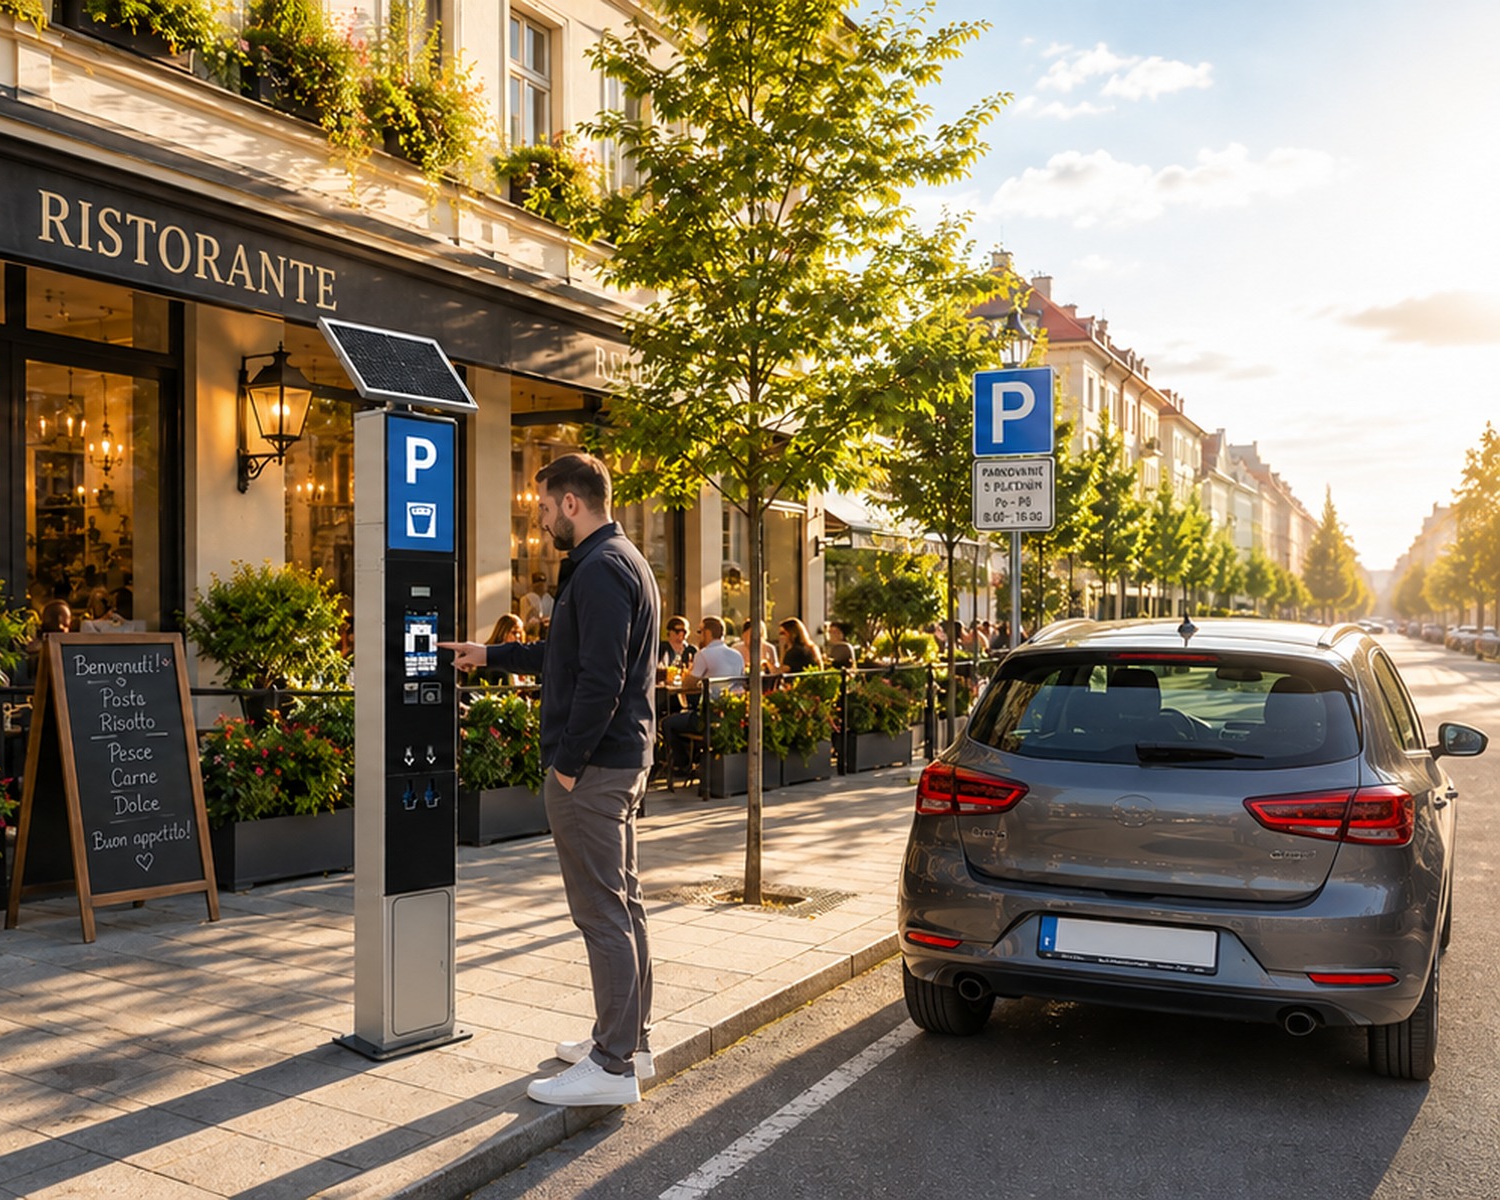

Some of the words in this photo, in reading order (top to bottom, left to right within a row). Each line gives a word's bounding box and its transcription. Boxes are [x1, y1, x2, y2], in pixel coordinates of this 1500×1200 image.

[38, 189, 338, 311] RISTORANTE
[992, 381, 1035, 443] P
[406, 436, 437, 484] P
[99, 711, 155, 732] Risotto
[108, 742, 153, 763] Pesce
[111, 767, 158, 787] Carne
[114, 793, 160, 815] Dolce
[92, 830, 128, 851] Buon
